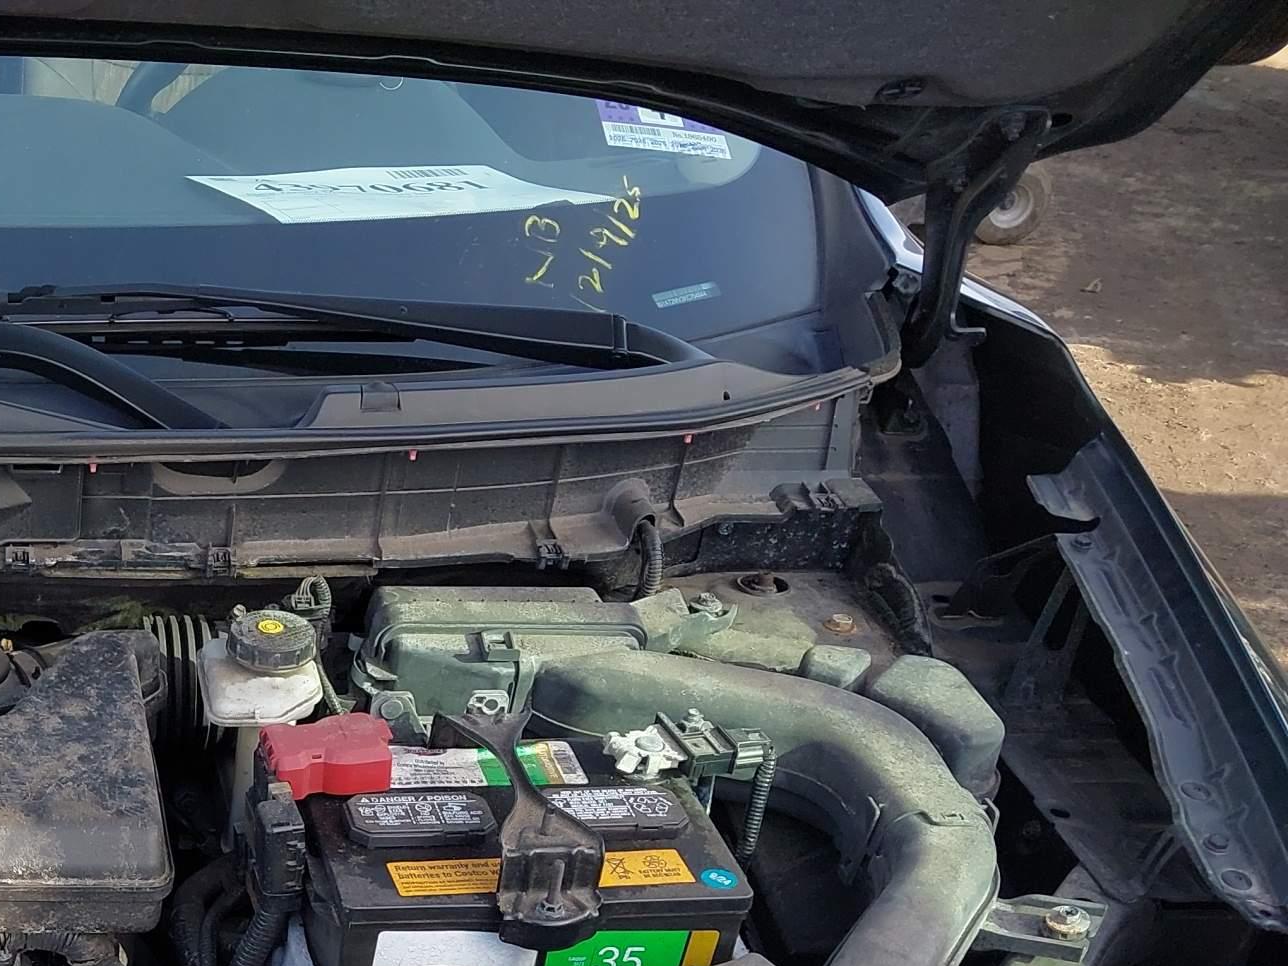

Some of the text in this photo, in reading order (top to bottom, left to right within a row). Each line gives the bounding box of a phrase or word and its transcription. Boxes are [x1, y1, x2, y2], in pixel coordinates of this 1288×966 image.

[254, 179, 489, 196] 43970681
[395, 864, 426, 872] Return
[428, 863, 469, 871] warranty
[398, 871, 441, 880] batteries
[454, 869, 488, 878] Costco
